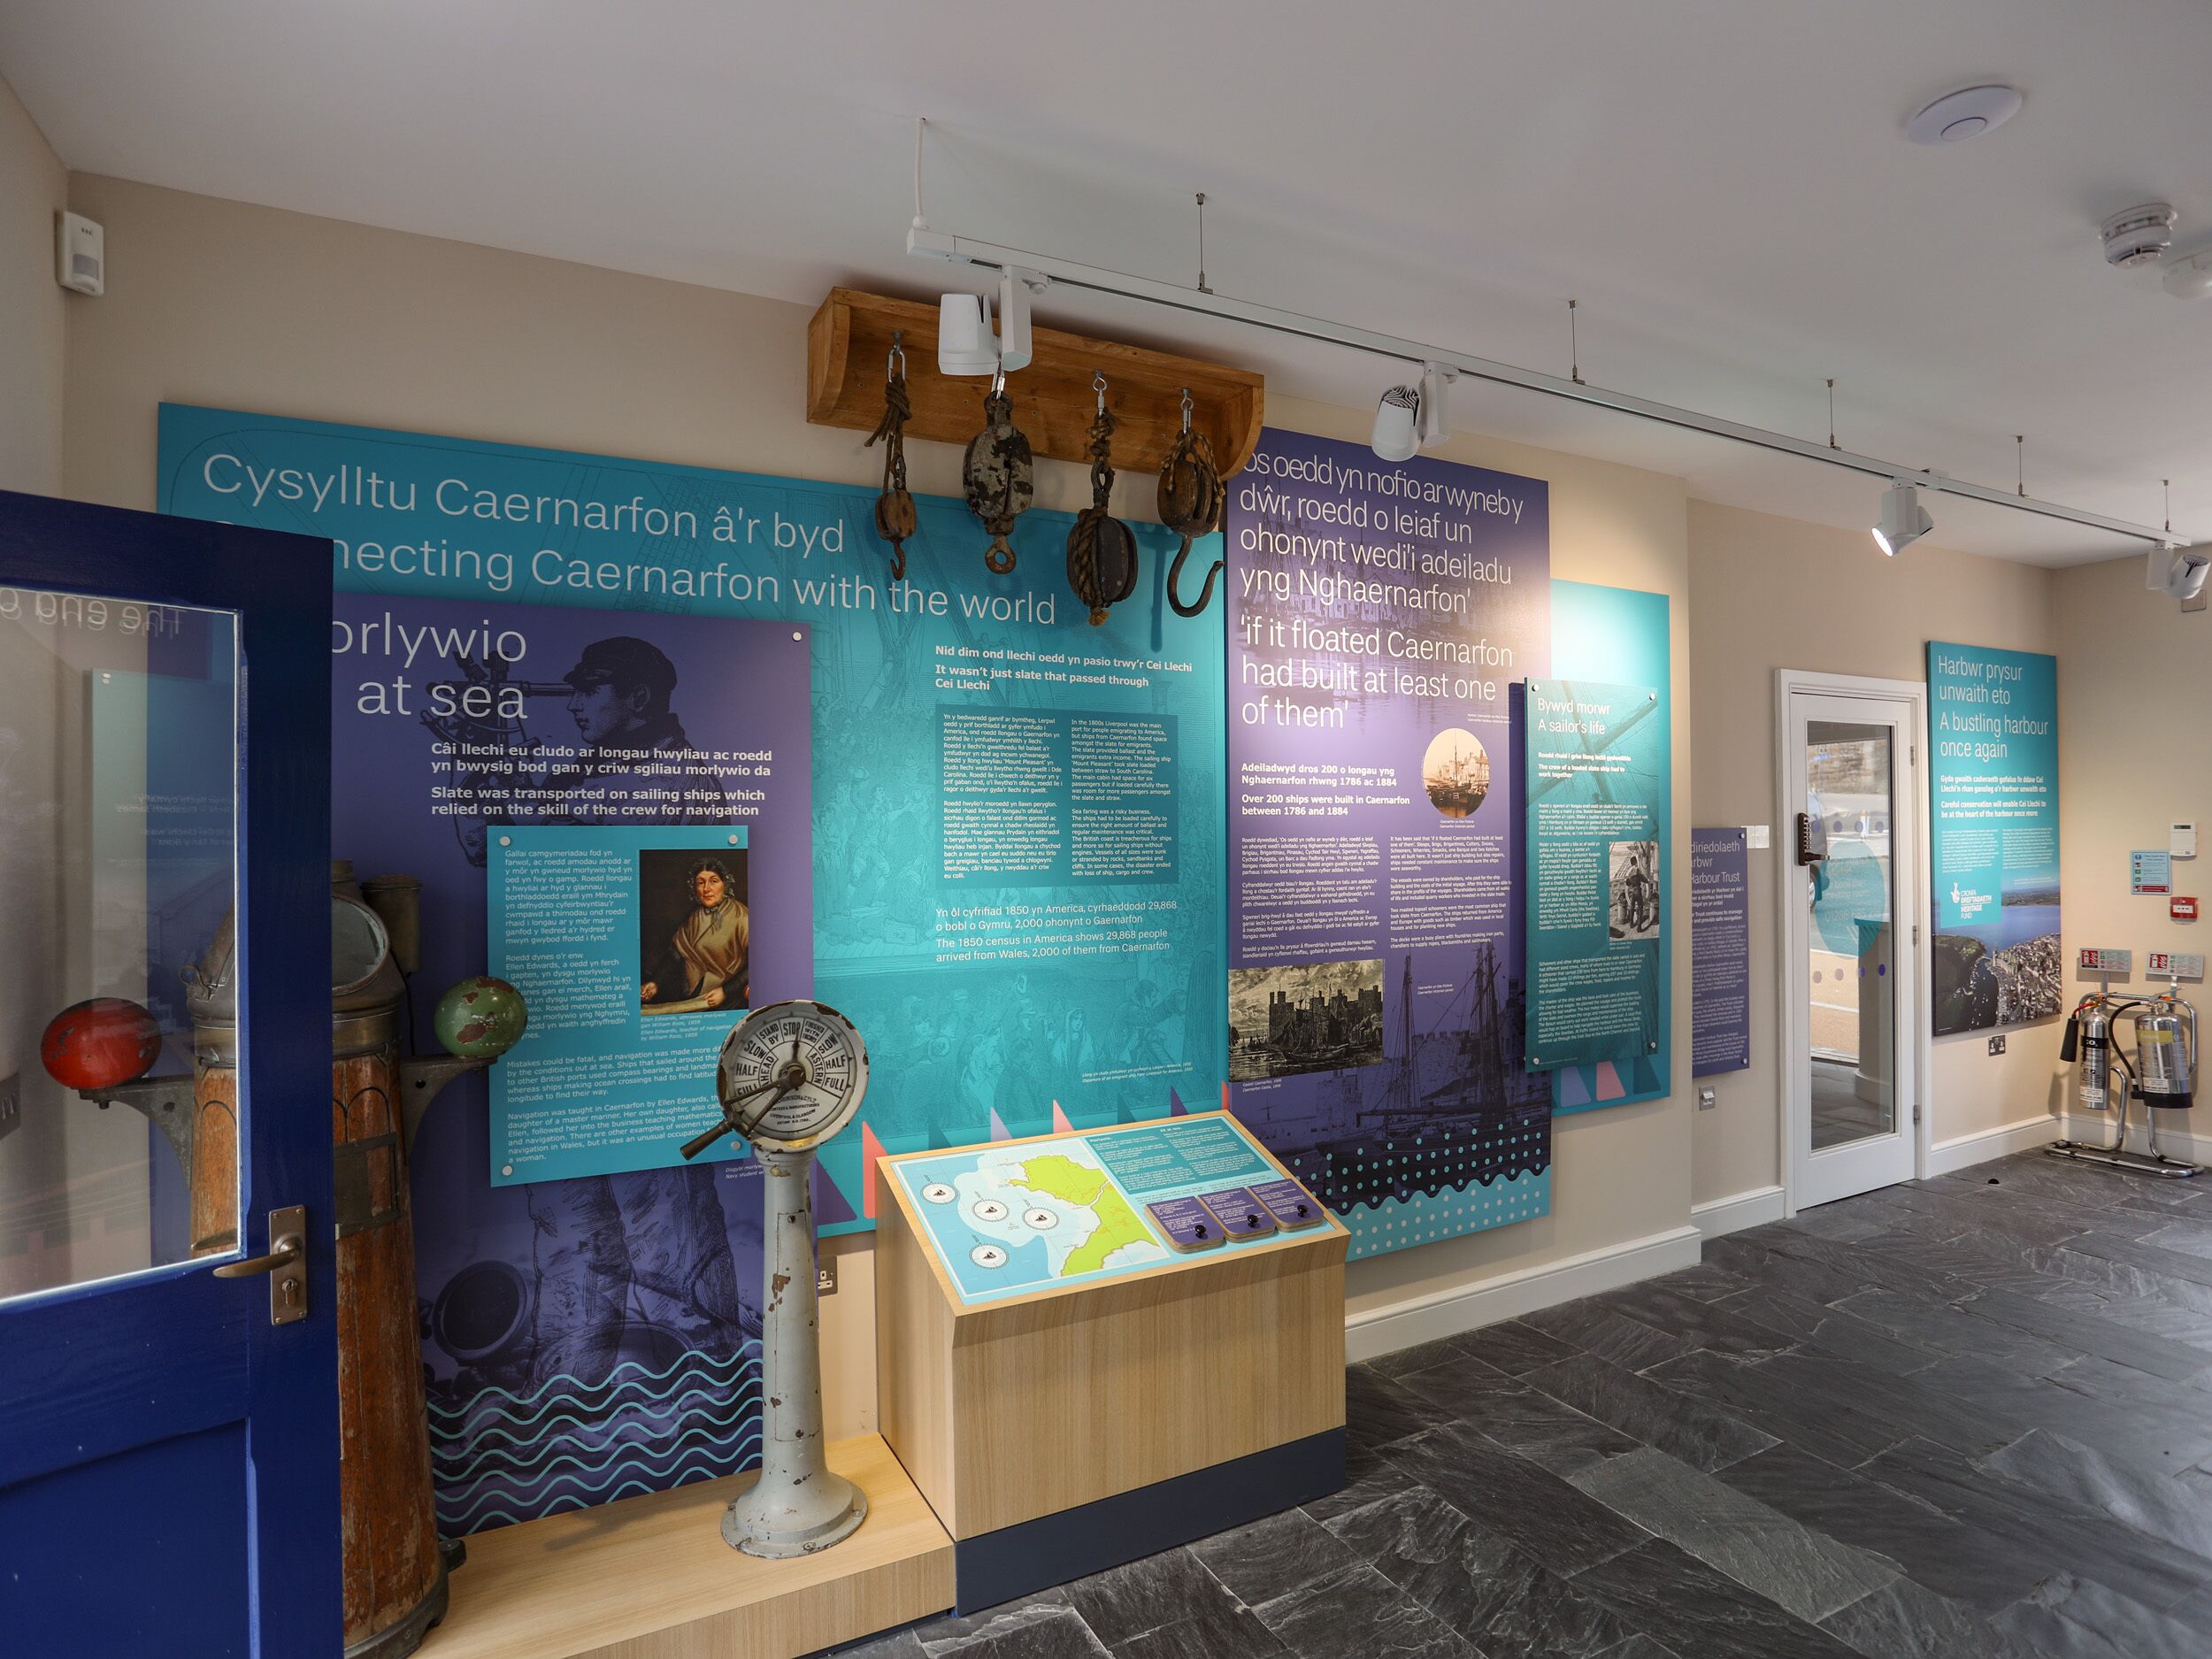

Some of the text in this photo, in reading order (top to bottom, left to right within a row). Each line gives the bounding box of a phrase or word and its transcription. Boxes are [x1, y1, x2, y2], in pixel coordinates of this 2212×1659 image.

[1273, 455, 1333, 485] oedd
[1336, 467, 1363, 494] yn
[1367, 470, 1421, 500] nofio
[1423, 482, 1445, 504] ar
[1445, 487, 1509, 515] wyneb
[1509, 498, 1524, 524] y
[204, 454, 843, 557] Cysylltu Caernarfon â'r byd
[1240, 484, 1471, 543] dŵr, roedd o leiaf un
[1240, 525, 1511, 584] ohonynt wedi'i adeiladu
[333, 541, 1055, 624] necting Caernarfon with the world
[1240, 569, 1290, 600] yng
[332, 611, 526, 669] orlywio
[1270, 618, 1286, 648] it
[1291, 620, 1380, 656] floated
[1386, 630, 1513, 667] Caernarfon
[935, 645, 1193, 672] Nid dim ond llechi oedd yn pasio trwy’r Cei Llechi
[935, 664, 1149, 688] It wasn’t just slate that passed through
[1242, 656, 1496, 701] had built at least one
[1939, 655, 2023, 685] Harbwr prysur
[935, 678, 990, 690] Cei Llechi
[357, 675, 528, 718] at sea
[1939, 683, 2010, 705] unwaith eto
[1241, 695, 1269, 726] of
[1538, 698, 1611, 716] Bywyd morwr
[1538, 718, 1606, 734] A sailor's life
[1939, 711, 2048, 738] A bustling harbour
[1939, 739, 2007, 763] once again
[431, 787, 765, 803] Slate was transported on sailing ships which
[1241, 794, 1263, 803] Over
[1266, 794, 1284, 803] 200
[1286, 794, 1309, 806] ships
[1335, 795, 1354, 804] built
[1356, 795, 1364, 804] in
[1366, 795, 1410, 804] Caernarfon
[432, 803, 759, 818] relied on the skill of the crew for navigation
[1083, 807, 1098, 816] faring
[1242, 805, 1348, 816] between 1786 and 1884
[1691, 841, 1740, 853] diriedolaeth
[1721, 872, 1740, 882] Trust
[936, 929, 1168, 948] The 1850 census in America shows 29,868 people
[936, 941, 1170, 961] arrived from Wales, 2,000 of them from Caernarfon
[759, 1023, 779, 1039] STAND
[783, 1022, 801, 1036] STOP
[805, 1021, 825, 1033] FINISHED
[805, 1028, 819, 1037] WITH
[768, 1034, 780, 1044] BY
[818, 1033, 838, 1054] SLOW
[744, 1041, 768, 1059] SLOW
[736, 1063, 758, 1076] HALF
[810, 1052, 823, 1084] ASTERN
[826, 1055, 846, 1069] HALF
[825, 1078, 844, 1091] FULL
